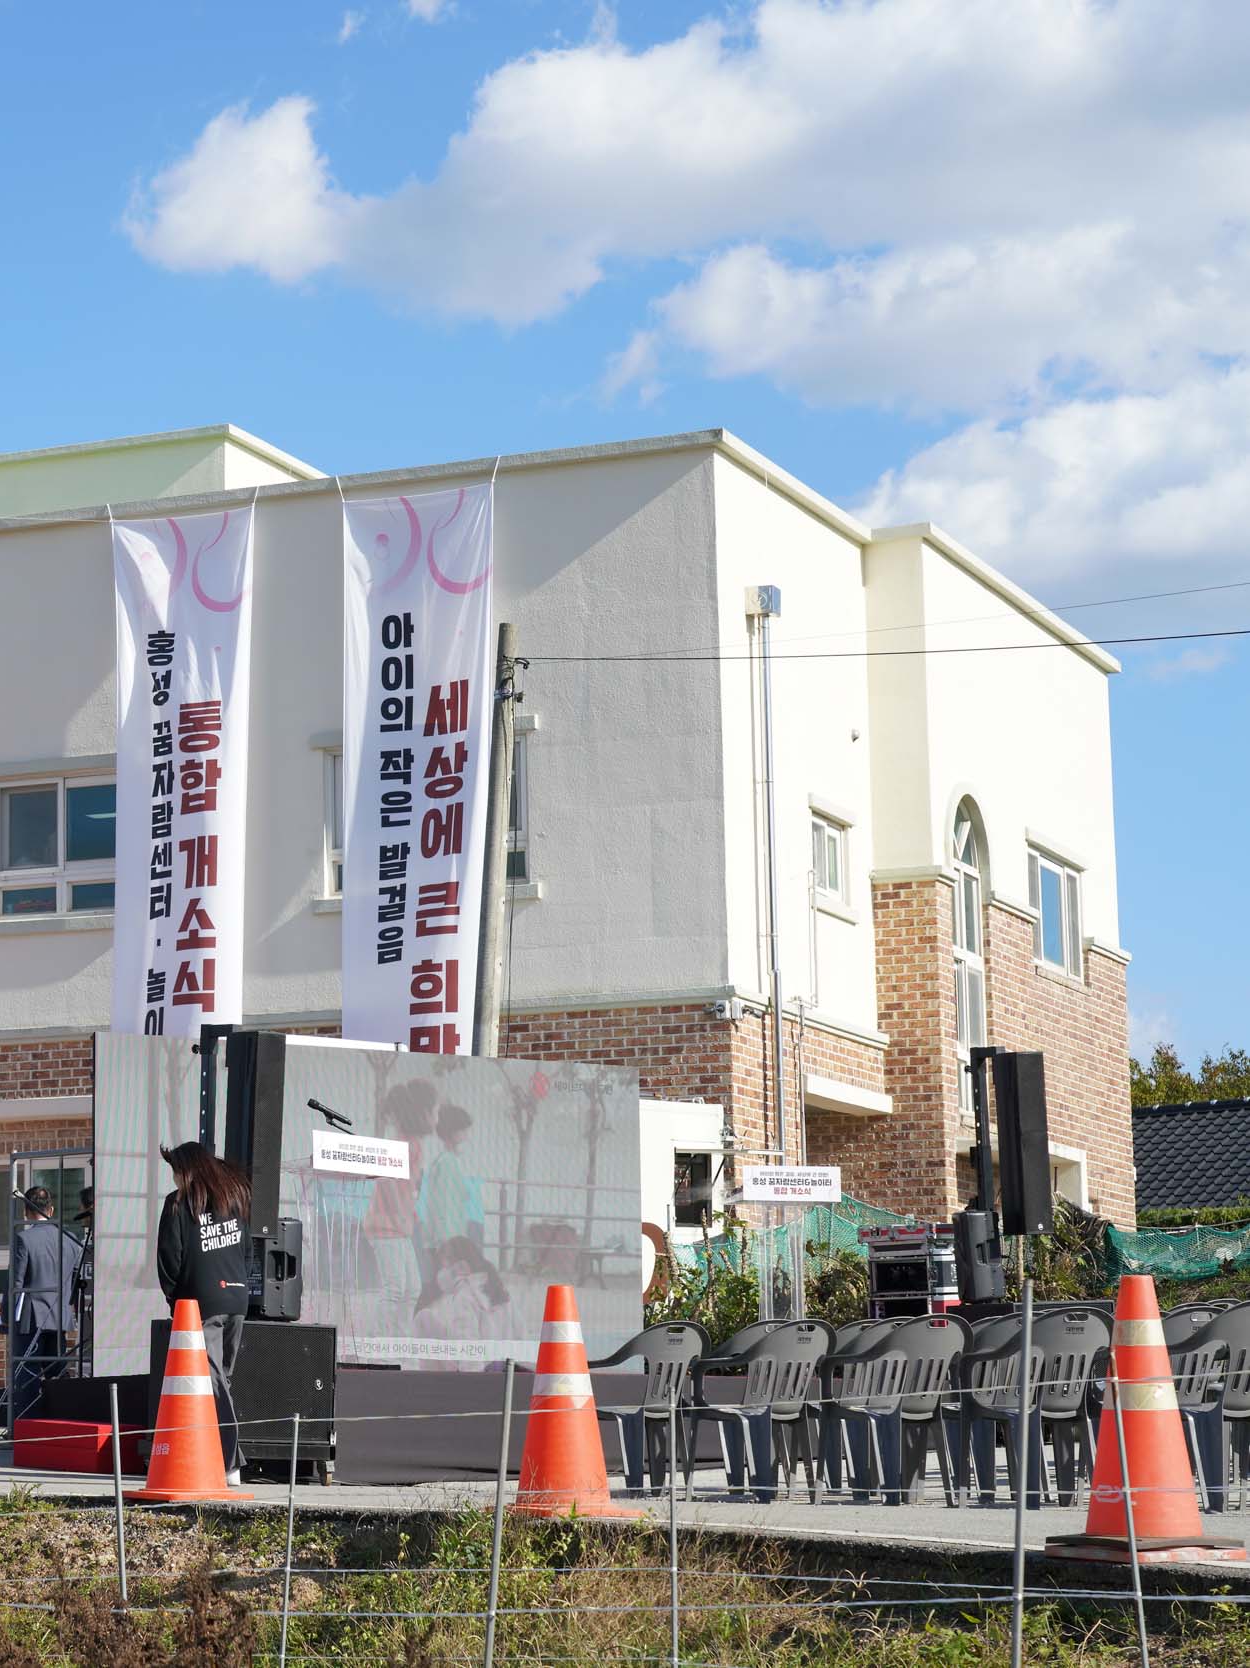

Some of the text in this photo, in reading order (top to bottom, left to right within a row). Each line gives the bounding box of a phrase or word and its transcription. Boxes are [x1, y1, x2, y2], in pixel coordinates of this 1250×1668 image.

[146, 630, 175, 706] 홍성
[377, 612, 414, 965] 아이의 작은 발걸음
[420, 678, 469, 859] 세상에
[150, 720, 174, 920] 꿈자람센터
[172, 699, 222, 1013] 통합 개소식
[415, 881, 461, 938] 큰
[198, 1212, 213, 1226] WE
[200, 1218, 239, 1239] SAVE THE
[201, 1230, 242, 1252] CHILDREN
